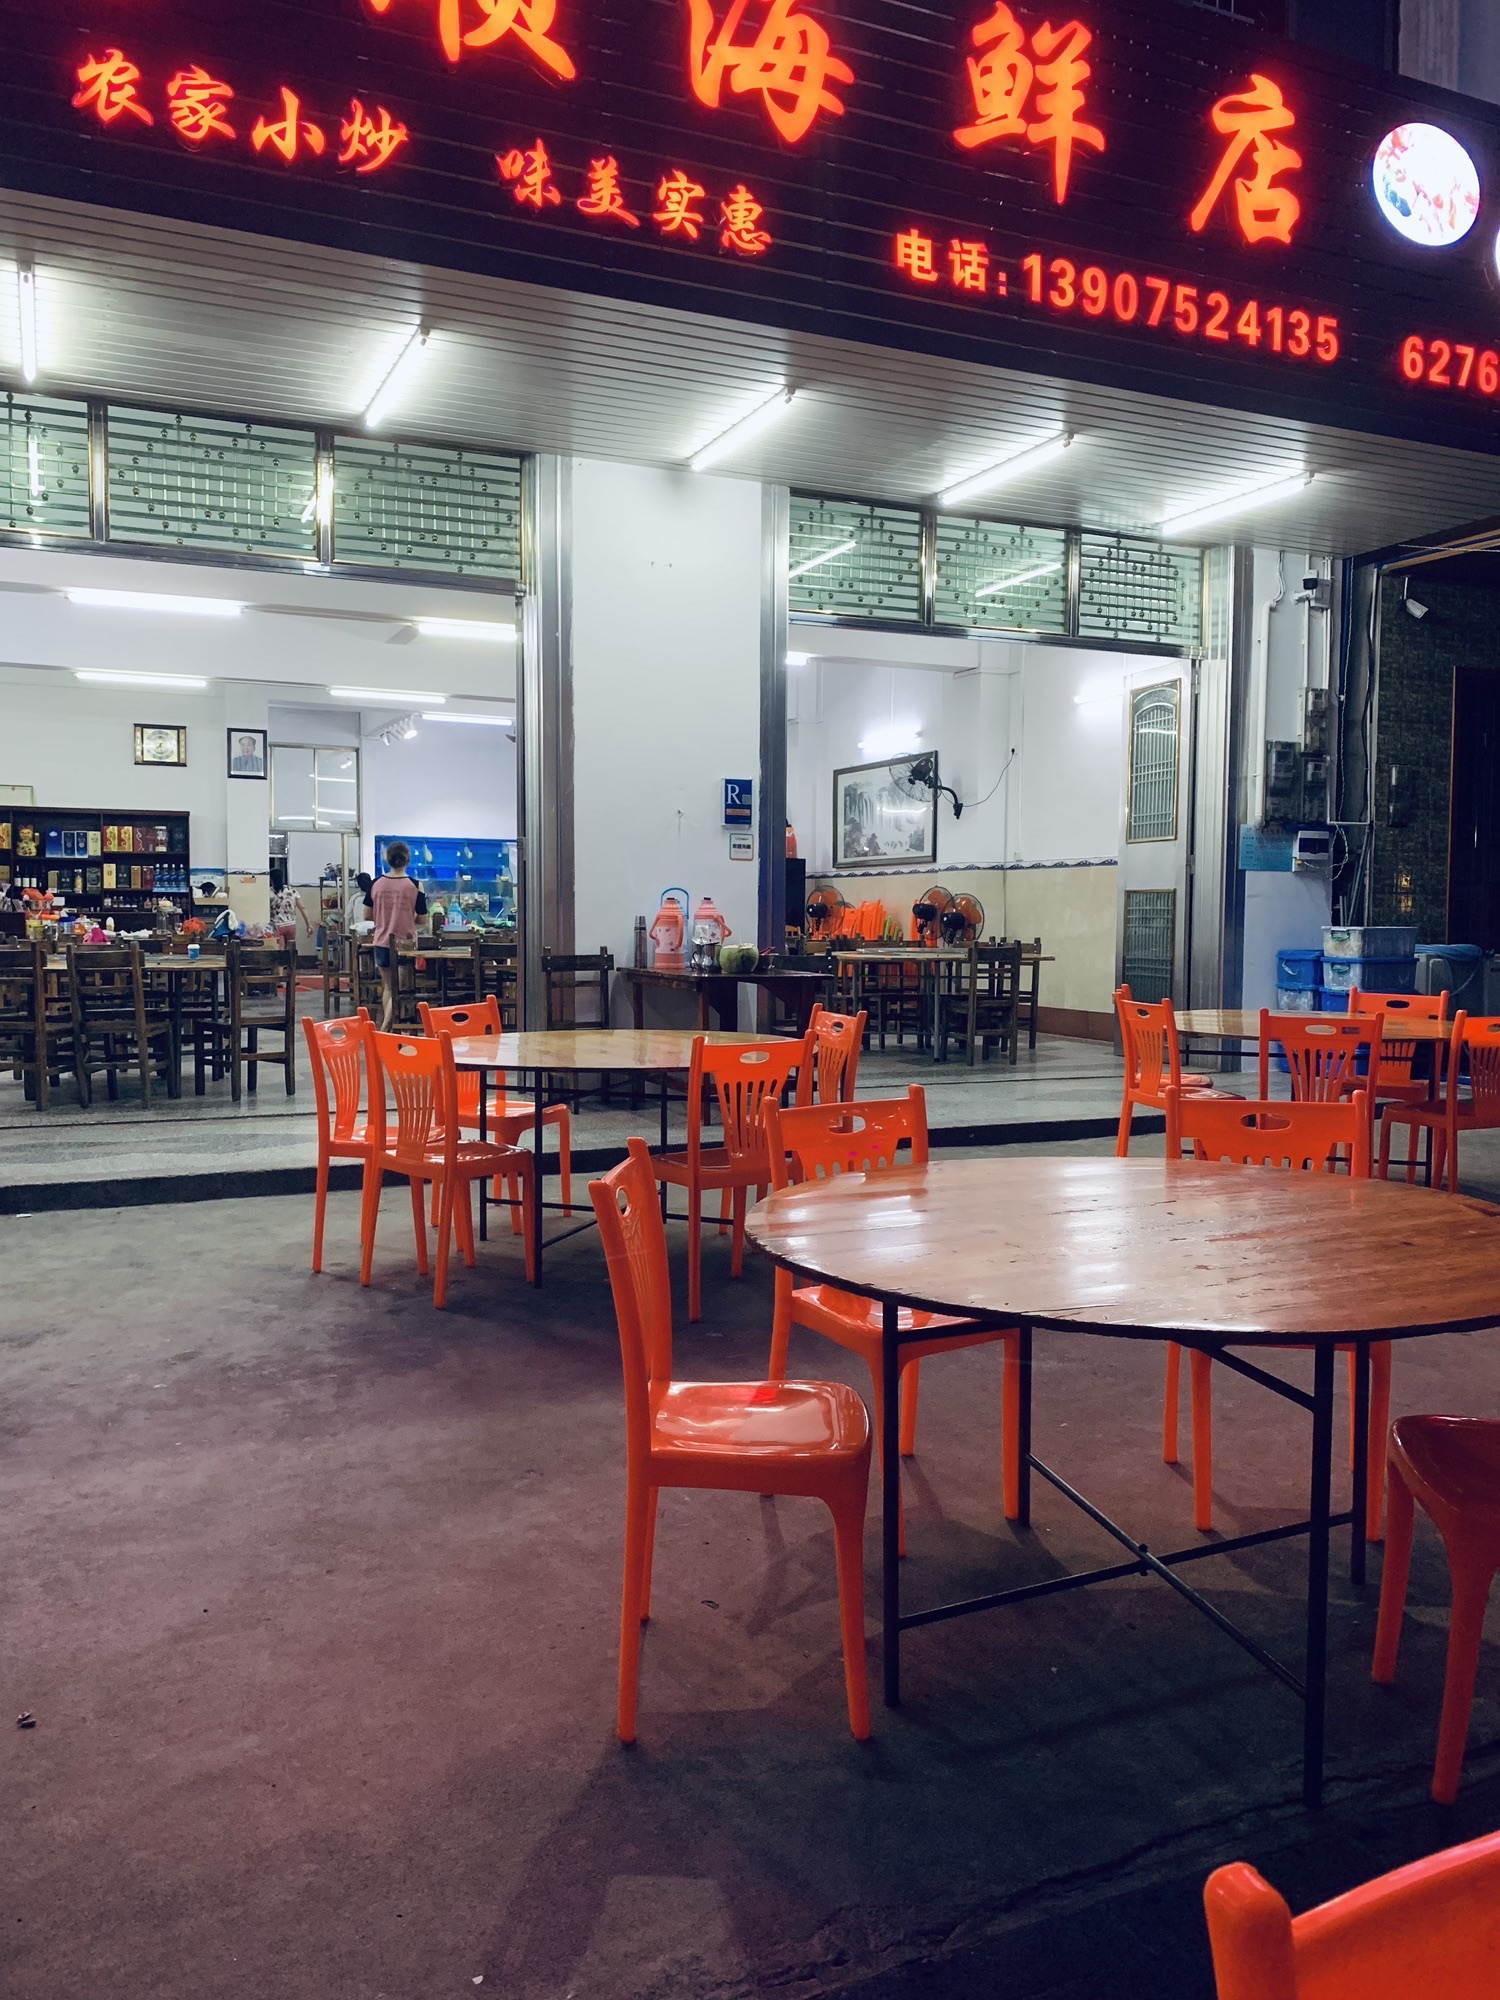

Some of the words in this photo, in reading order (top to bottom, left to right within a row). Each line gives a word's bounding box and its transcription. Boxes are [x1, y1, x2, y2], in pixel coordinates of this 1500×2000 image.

[72, 48, 408, 172] 农家小炒
[496, 139, 773, 255] 味美实惠
[1402, 336, 1499, 393] 6276
